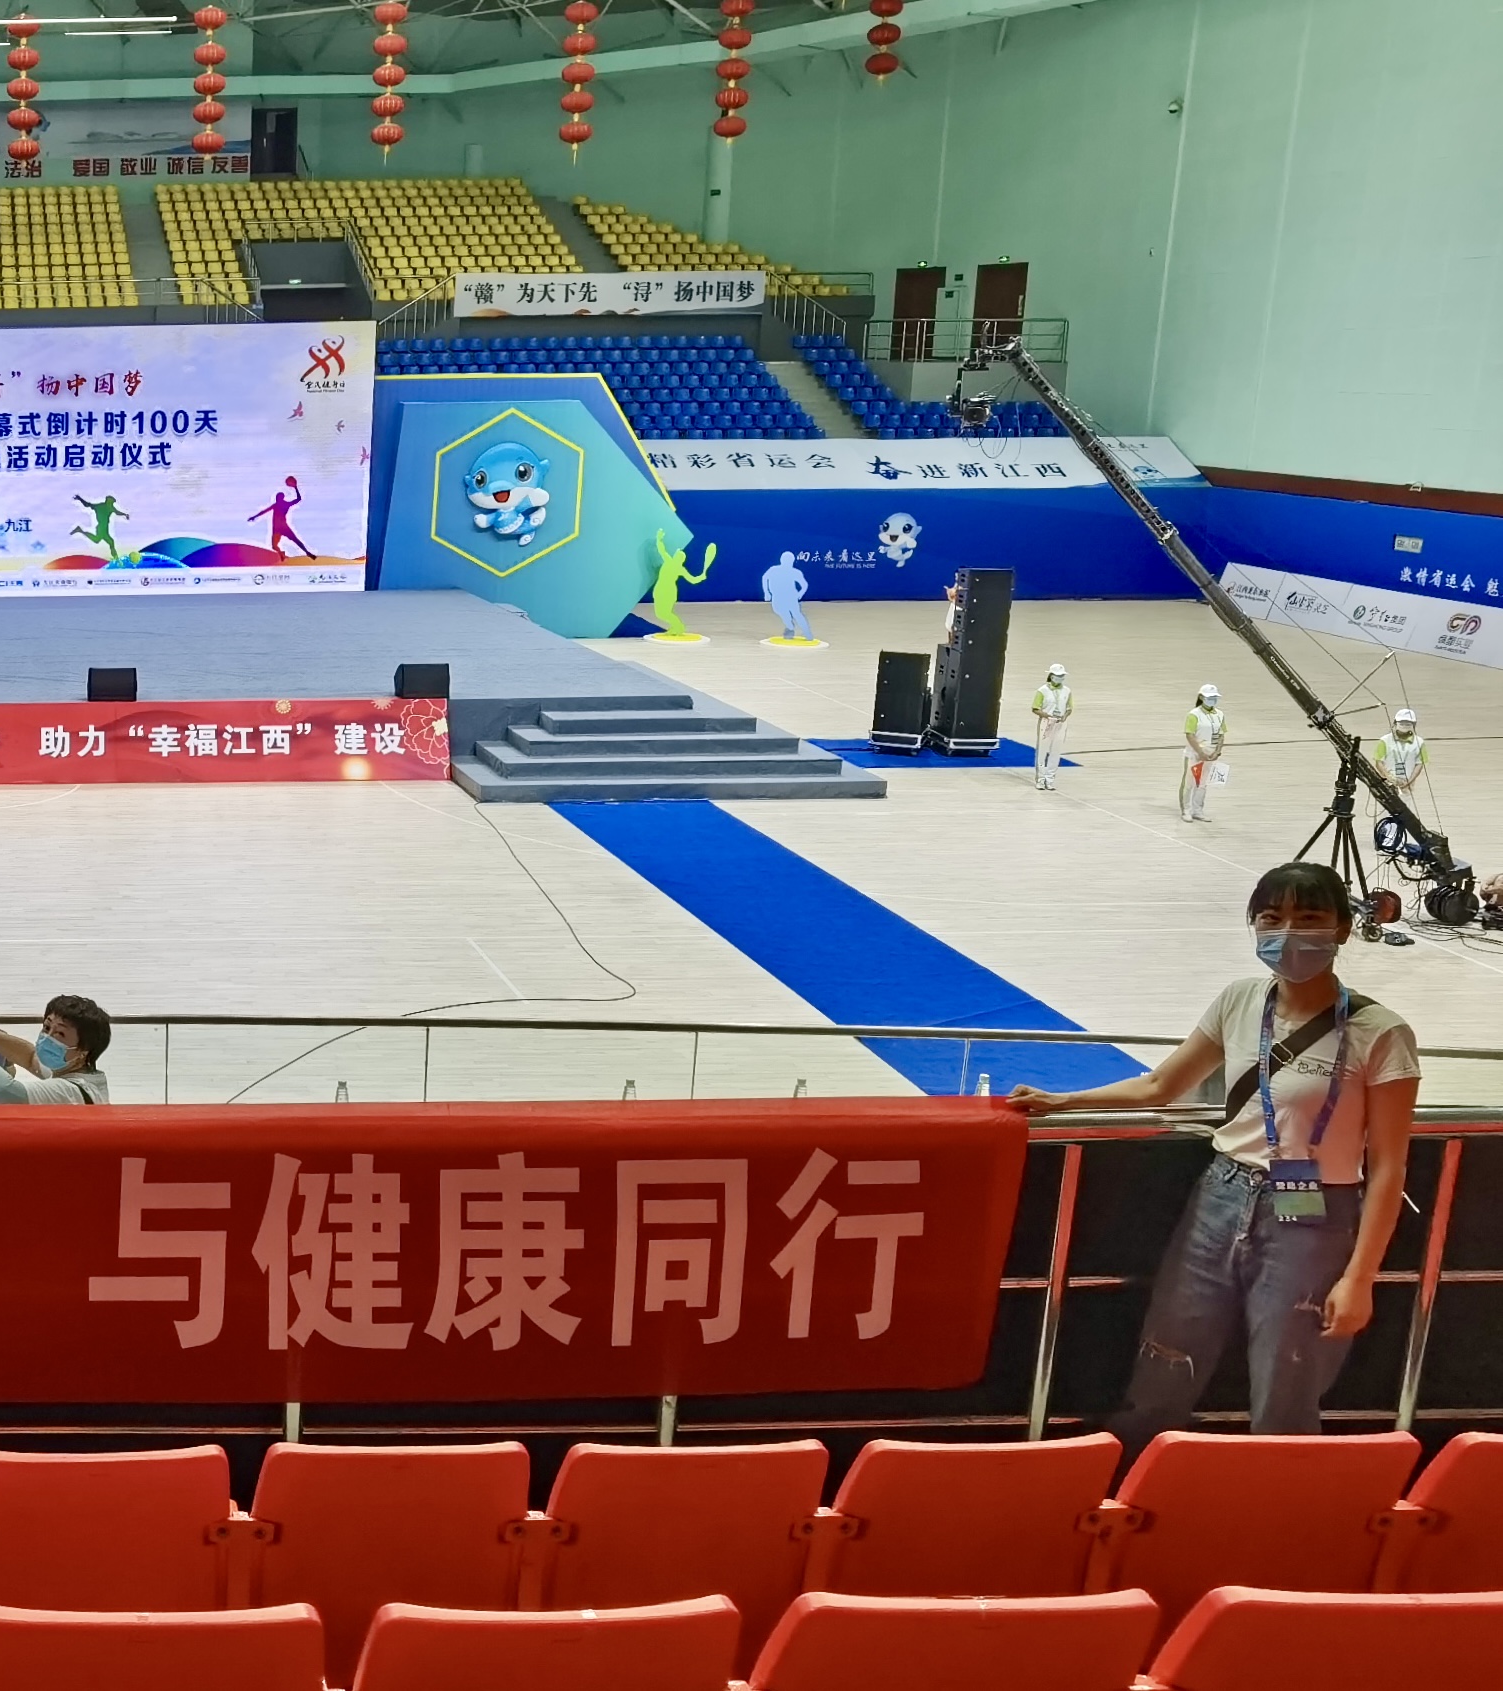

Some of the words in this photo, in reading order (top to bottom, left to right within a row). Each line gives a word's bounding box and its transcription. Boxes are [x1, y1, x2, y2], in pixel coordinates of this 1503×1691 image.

[4, 160, 42, 178] 法治
[73, 159, 110, 177] 爱国
[120, 158, 157, 176] 敬业
[167, 157, 204, 175] 诚信
[211, 156, 248, 175] 友善
[866, 454, 1069, 480] 奋进新江西
[796, 549, 877, 563] 向未来看这里
[88, 1146, 927, 1355] 与健康同行
